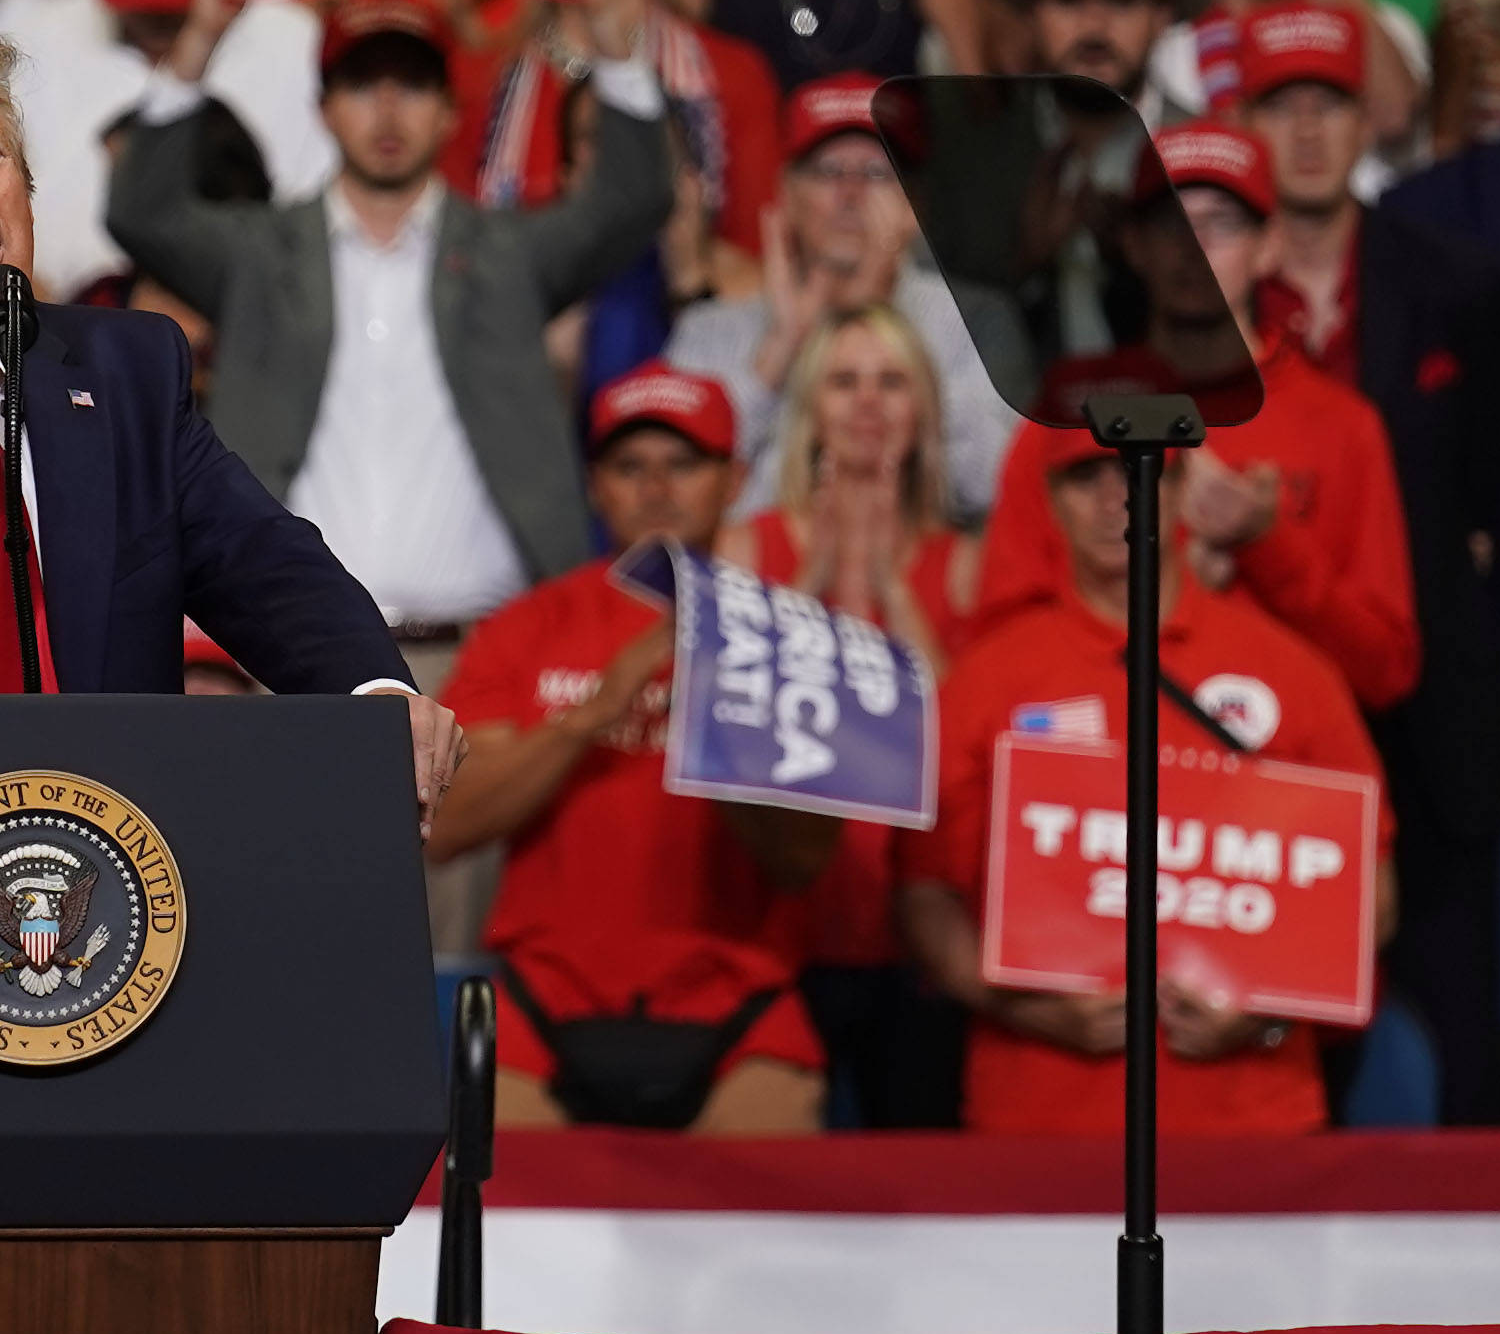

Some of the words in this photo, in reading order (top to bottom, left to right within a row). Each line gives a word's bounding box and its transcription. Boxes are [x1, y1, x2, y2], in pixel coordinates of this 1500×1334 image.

[768, 579, 841, 786] ERICA
[834, 607, 899, 718] EEP
[39, 782, 67, 803] OF
[72, 789, 109, 819] THE
[114, 814, 178, 935] UNITED
[1019, 799, 1348, 888] TRUMP
[1085, 865, 1278, 935] 2020
[65, 961, 165, 1052] STATES
